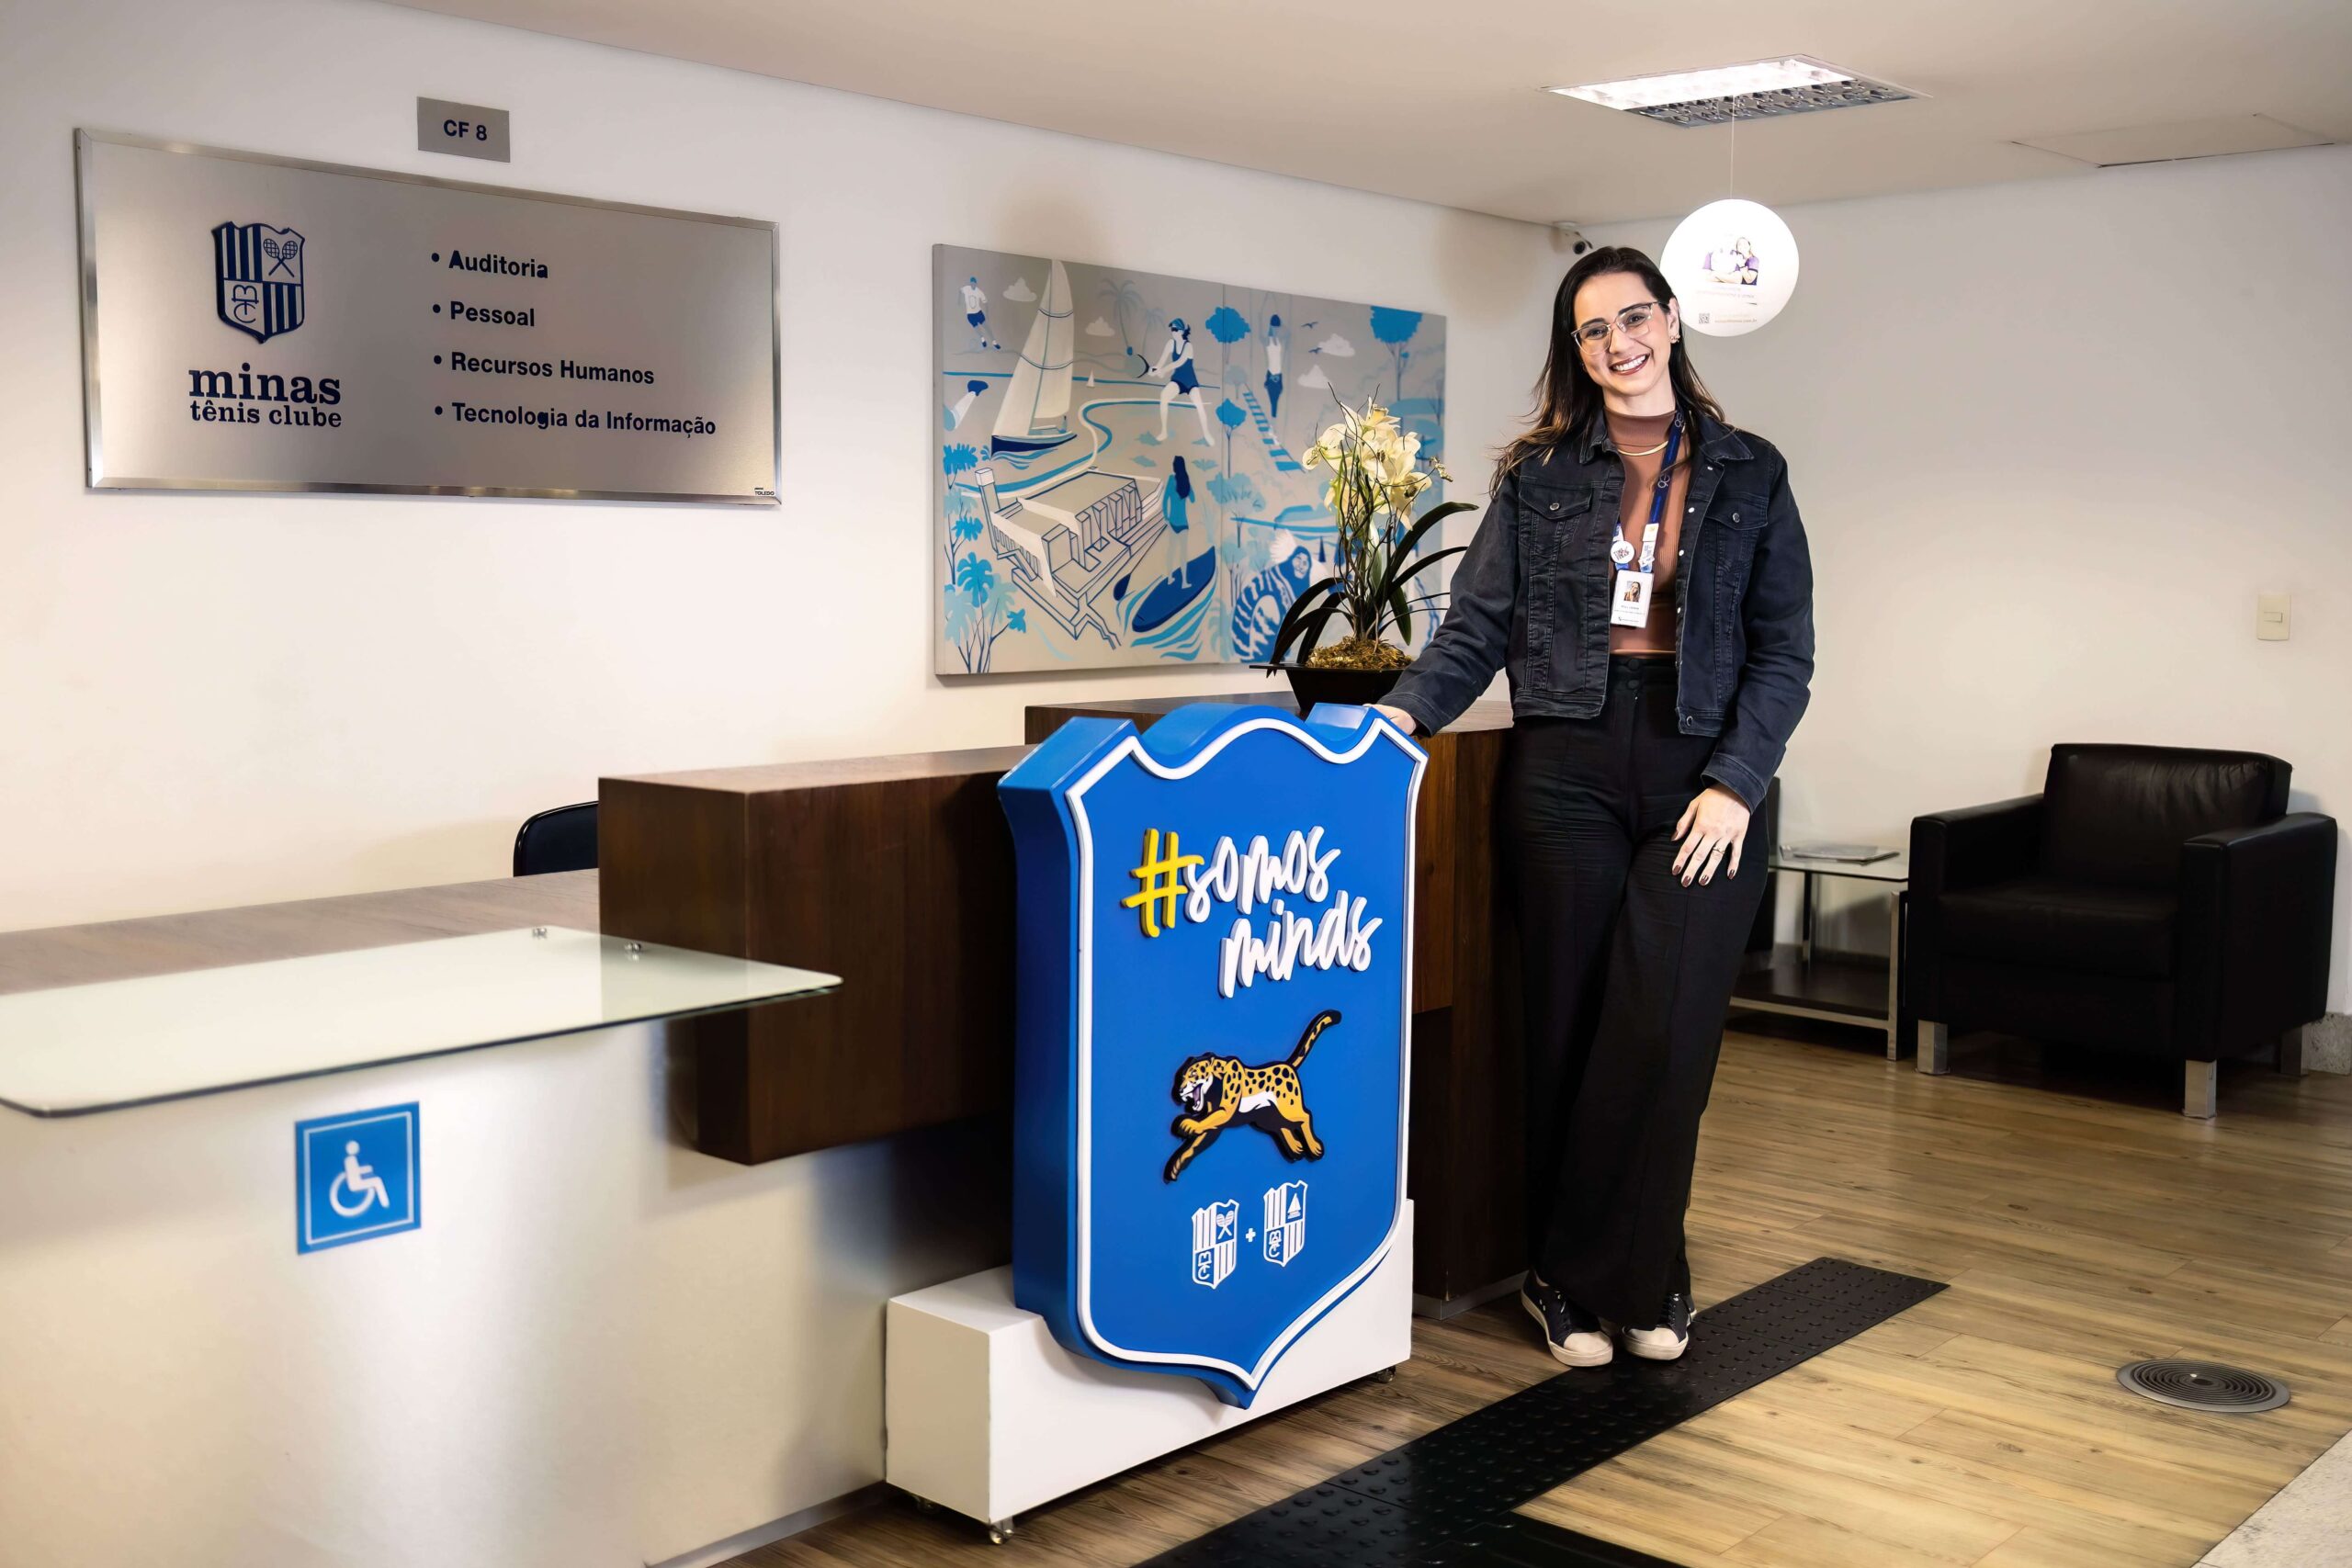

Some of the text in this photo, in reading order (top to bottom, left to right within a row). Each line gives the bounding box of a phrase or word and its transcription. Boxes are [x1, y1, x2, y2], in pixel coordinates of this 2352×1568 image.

[443, 118, 488, 141] CF 8
[448, 250, 549, 279] Auditoria
[450, 300, 536, 327] Pessoal
[451, 352, 655, 385] Recursos Humanos
[188, 362, 342, 406] minas
[190, 400, 343, 428] tênis clube
[451, 402, 717, 439] Tecnologia da Informação
